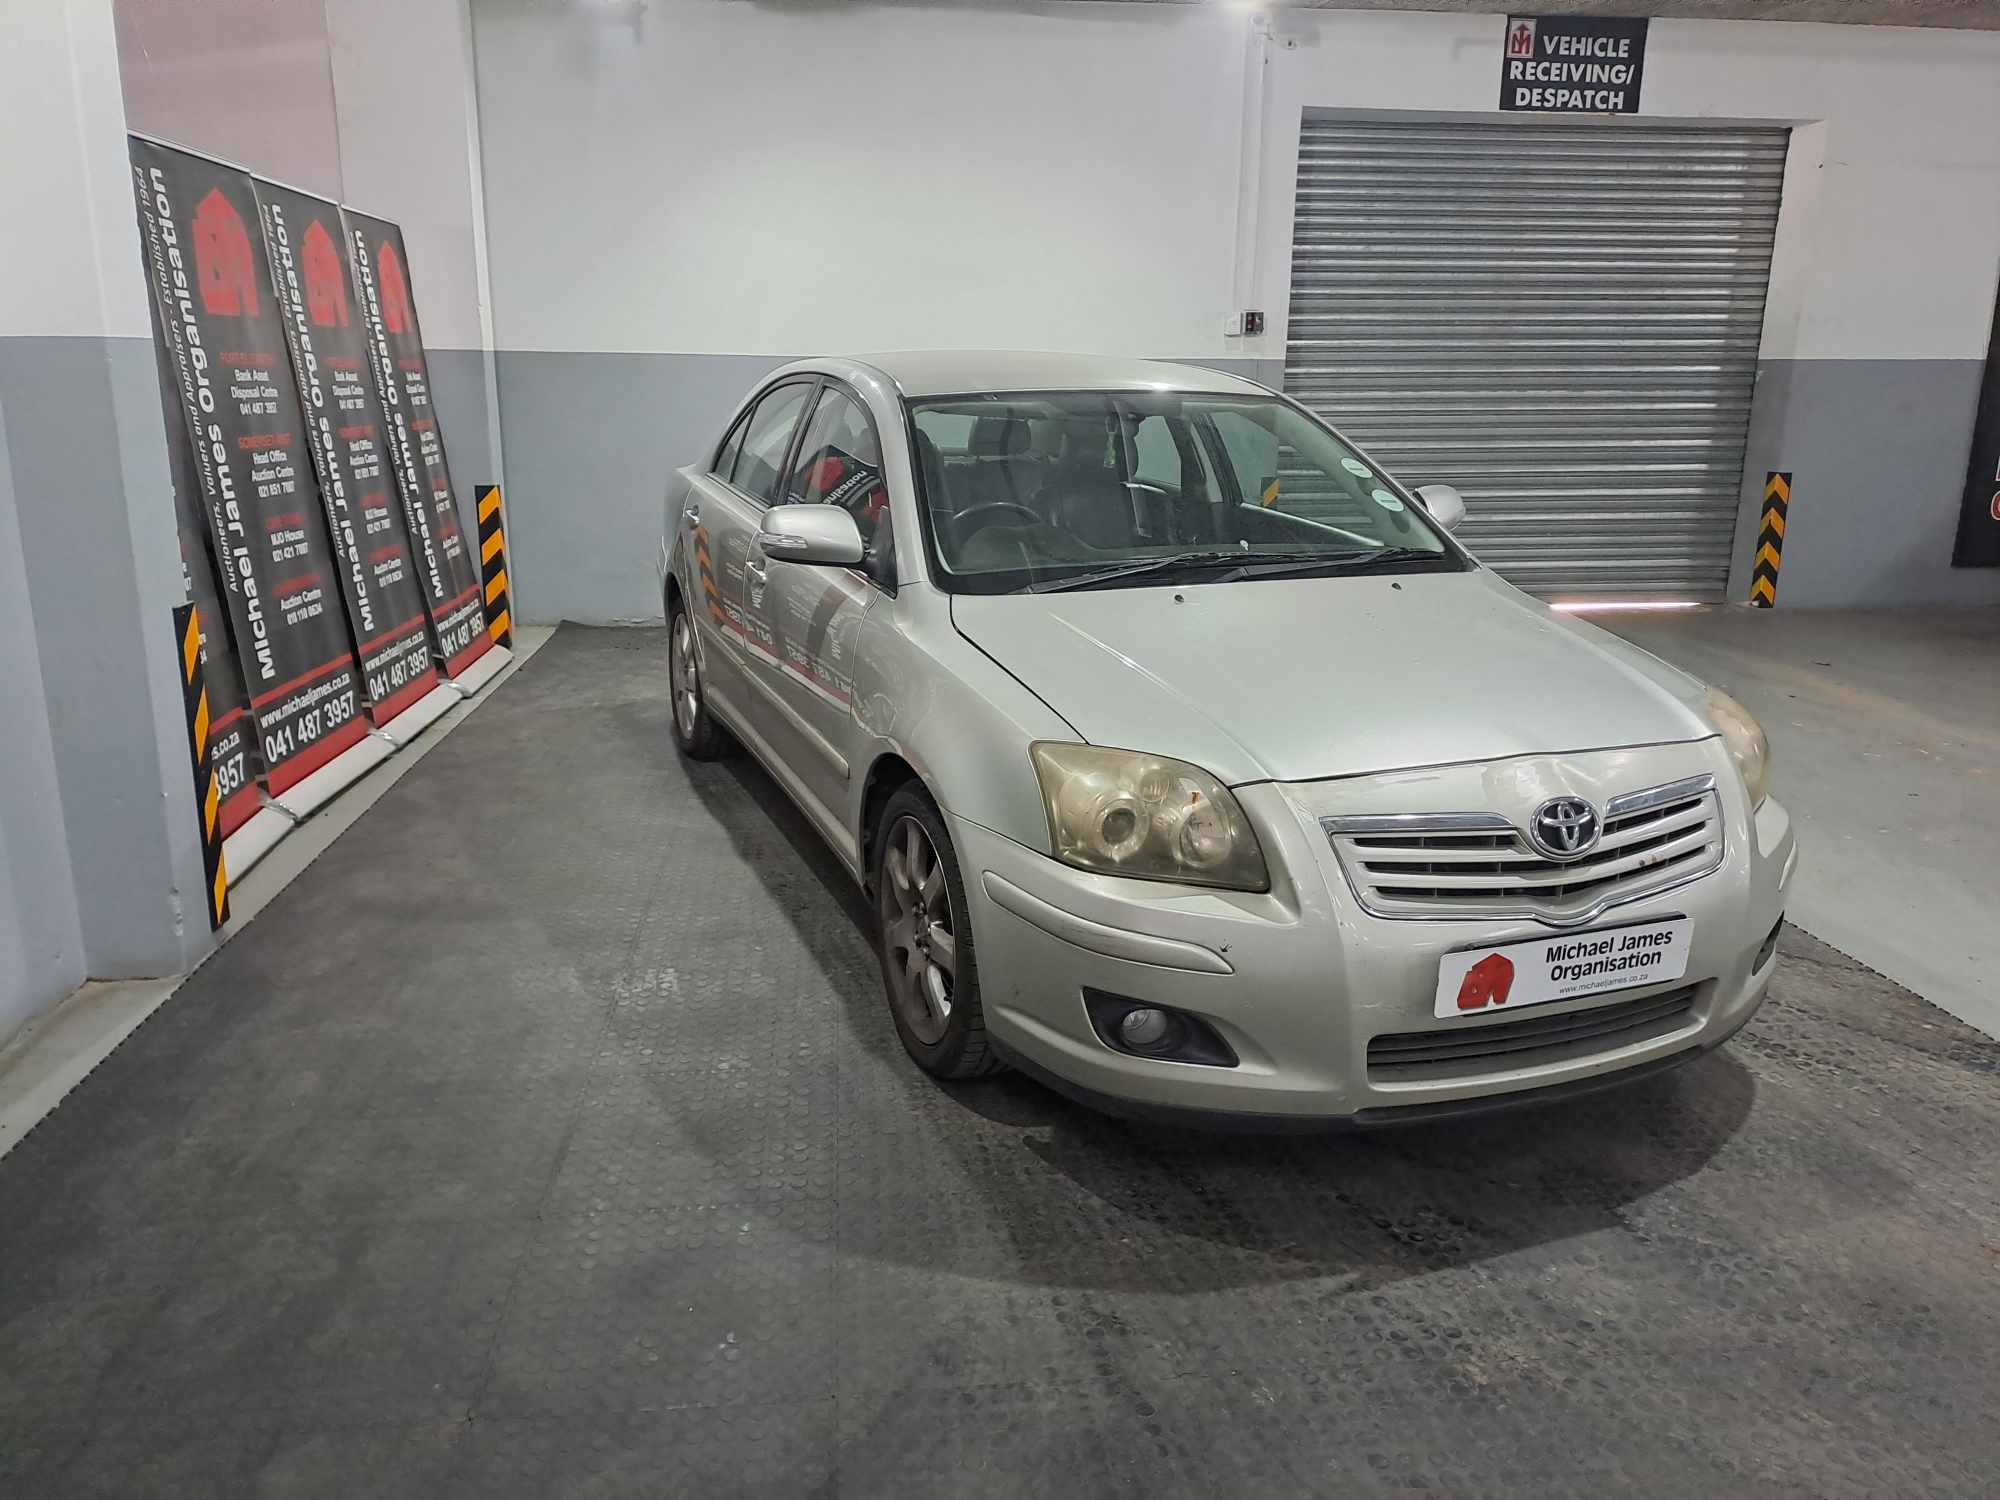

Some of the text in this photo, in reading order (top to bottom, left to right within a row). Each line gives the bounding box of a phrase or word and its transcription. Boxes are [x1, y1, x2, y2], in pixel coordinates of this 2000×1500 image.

[1509, 60, 1635, 85] RECEIVING/
[1543, 35, 1631, 58] VEHICLE
[1515, 87, 1624, 110] DESPATCH
[143, 210, 173, 305] Established
[271, 204, 324, 408] Organisation
[354, 230, 398, 405] Organisation
[170, 319, 195, 402] Appraisers
[149, 167, 276, 681] Michael James Organisation
[188, 405, 203, 436] and
[199, 439, 216, 495] Valuers
[319, 416, 348, 512] James
[394, 412, 419, 495] James
[339, 519, 375, 632] Michael
[412, 500, 444, 598] Michael
[441, 631, 459, 657] 041
[259, 672, 351, 729] www.michaeljames.co.za
[369, 645, 430, 701] 041 487 3957
[265, 690, 355, 763] 041 487 3957
[1546, 930, 1673, 964] Michael James
[1550, 951, 1662, 981] Organisation
[1559, 973, 1649, 994] www.michaeljames.co.za
